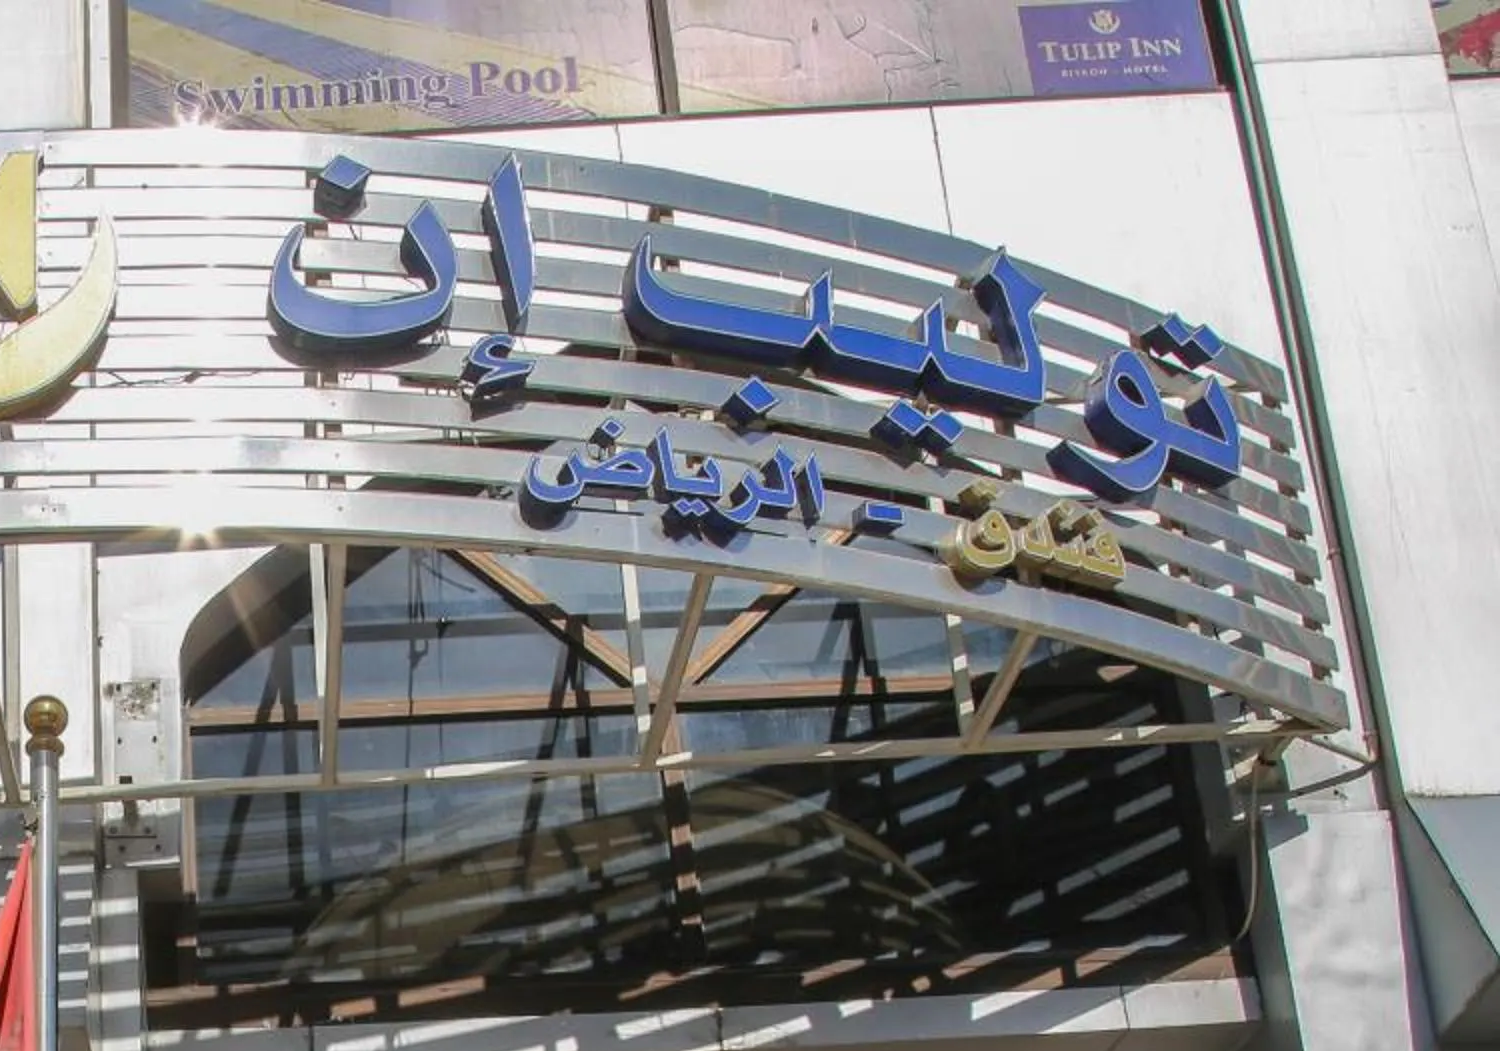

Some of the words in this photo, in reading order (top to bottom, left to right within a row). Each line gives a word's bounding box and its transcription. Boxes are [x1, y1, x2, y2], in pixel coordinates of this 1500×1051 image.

[173, 67, 452, 114] Swimming
[469, 56, 582, 98] Pool
[1038, 41, 1121, 63] TULIP
[1128, 37, 1182, 58] INN
[1123, 63, 1169, 75] HOTEL
[267, 153, 536, 395] إن
[623, 234, 1242, 497] توليب
[520, 419, 825, 532] الرياض
[950, 480, 1126, 584] فندق
